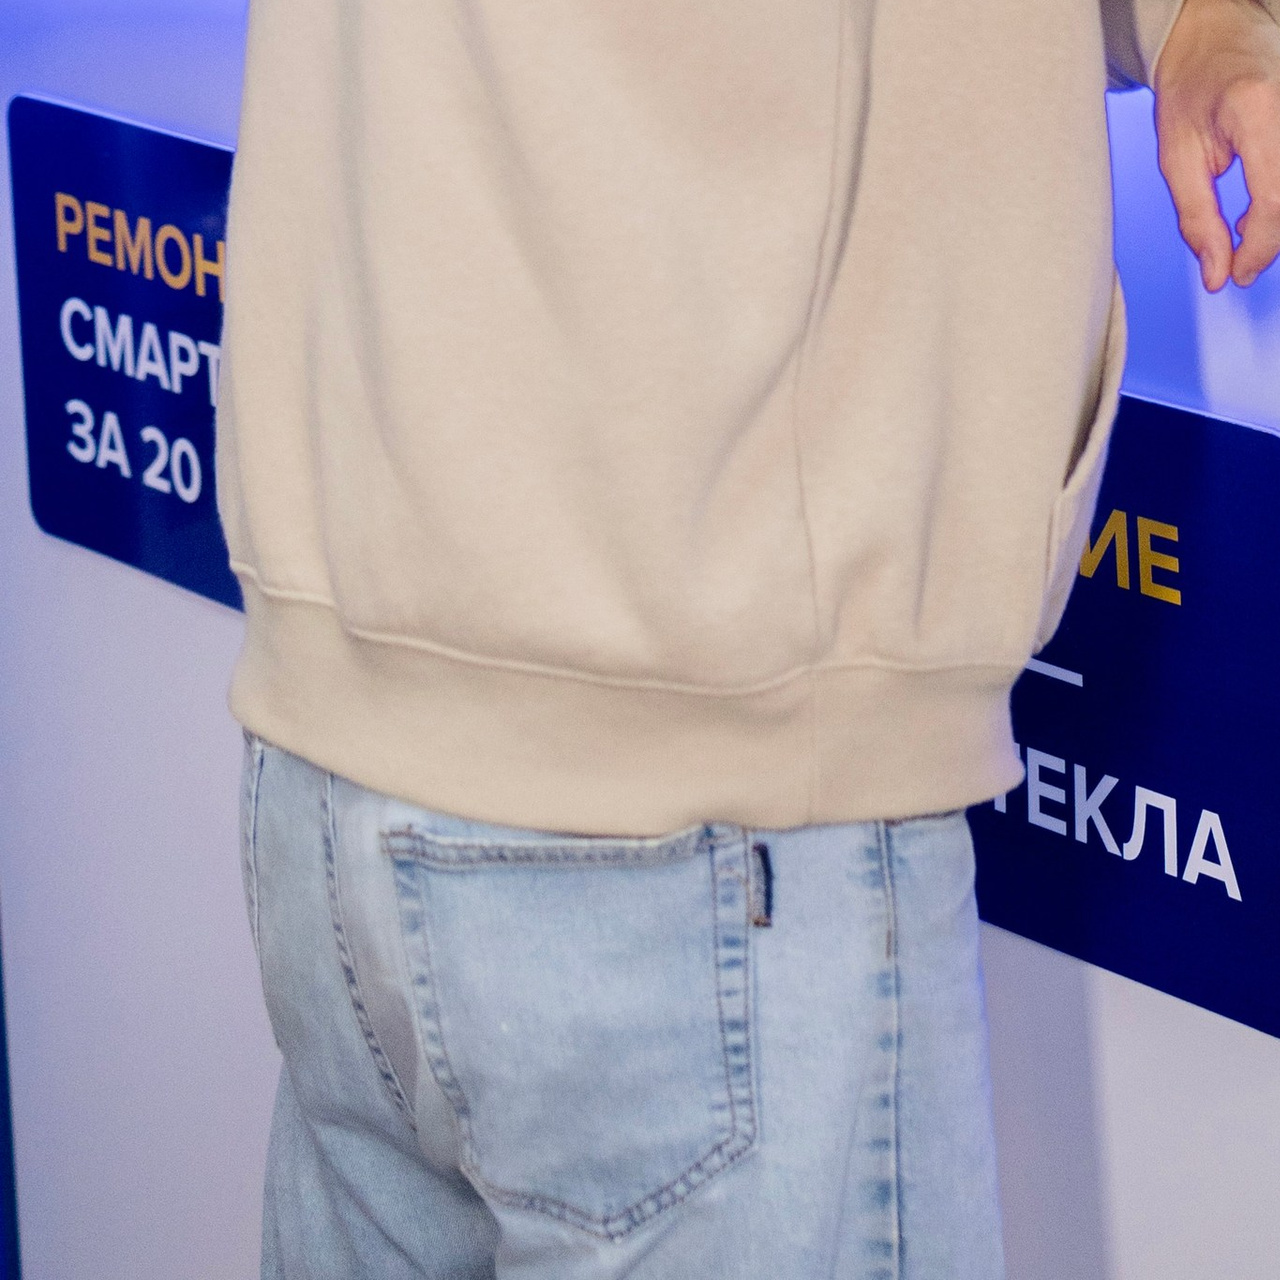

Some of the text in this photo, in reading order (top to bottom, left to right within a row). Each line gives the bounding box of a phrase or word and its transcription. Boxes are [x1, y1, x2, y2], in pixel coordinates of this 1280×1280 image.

[54, 192, 225, 303] РЕМОН
[60, 297, 221, 407] СМАРТ
[65, 398, 201, 504] ЗА 20
[994, 742, 1242, 902] ЕКЛА
